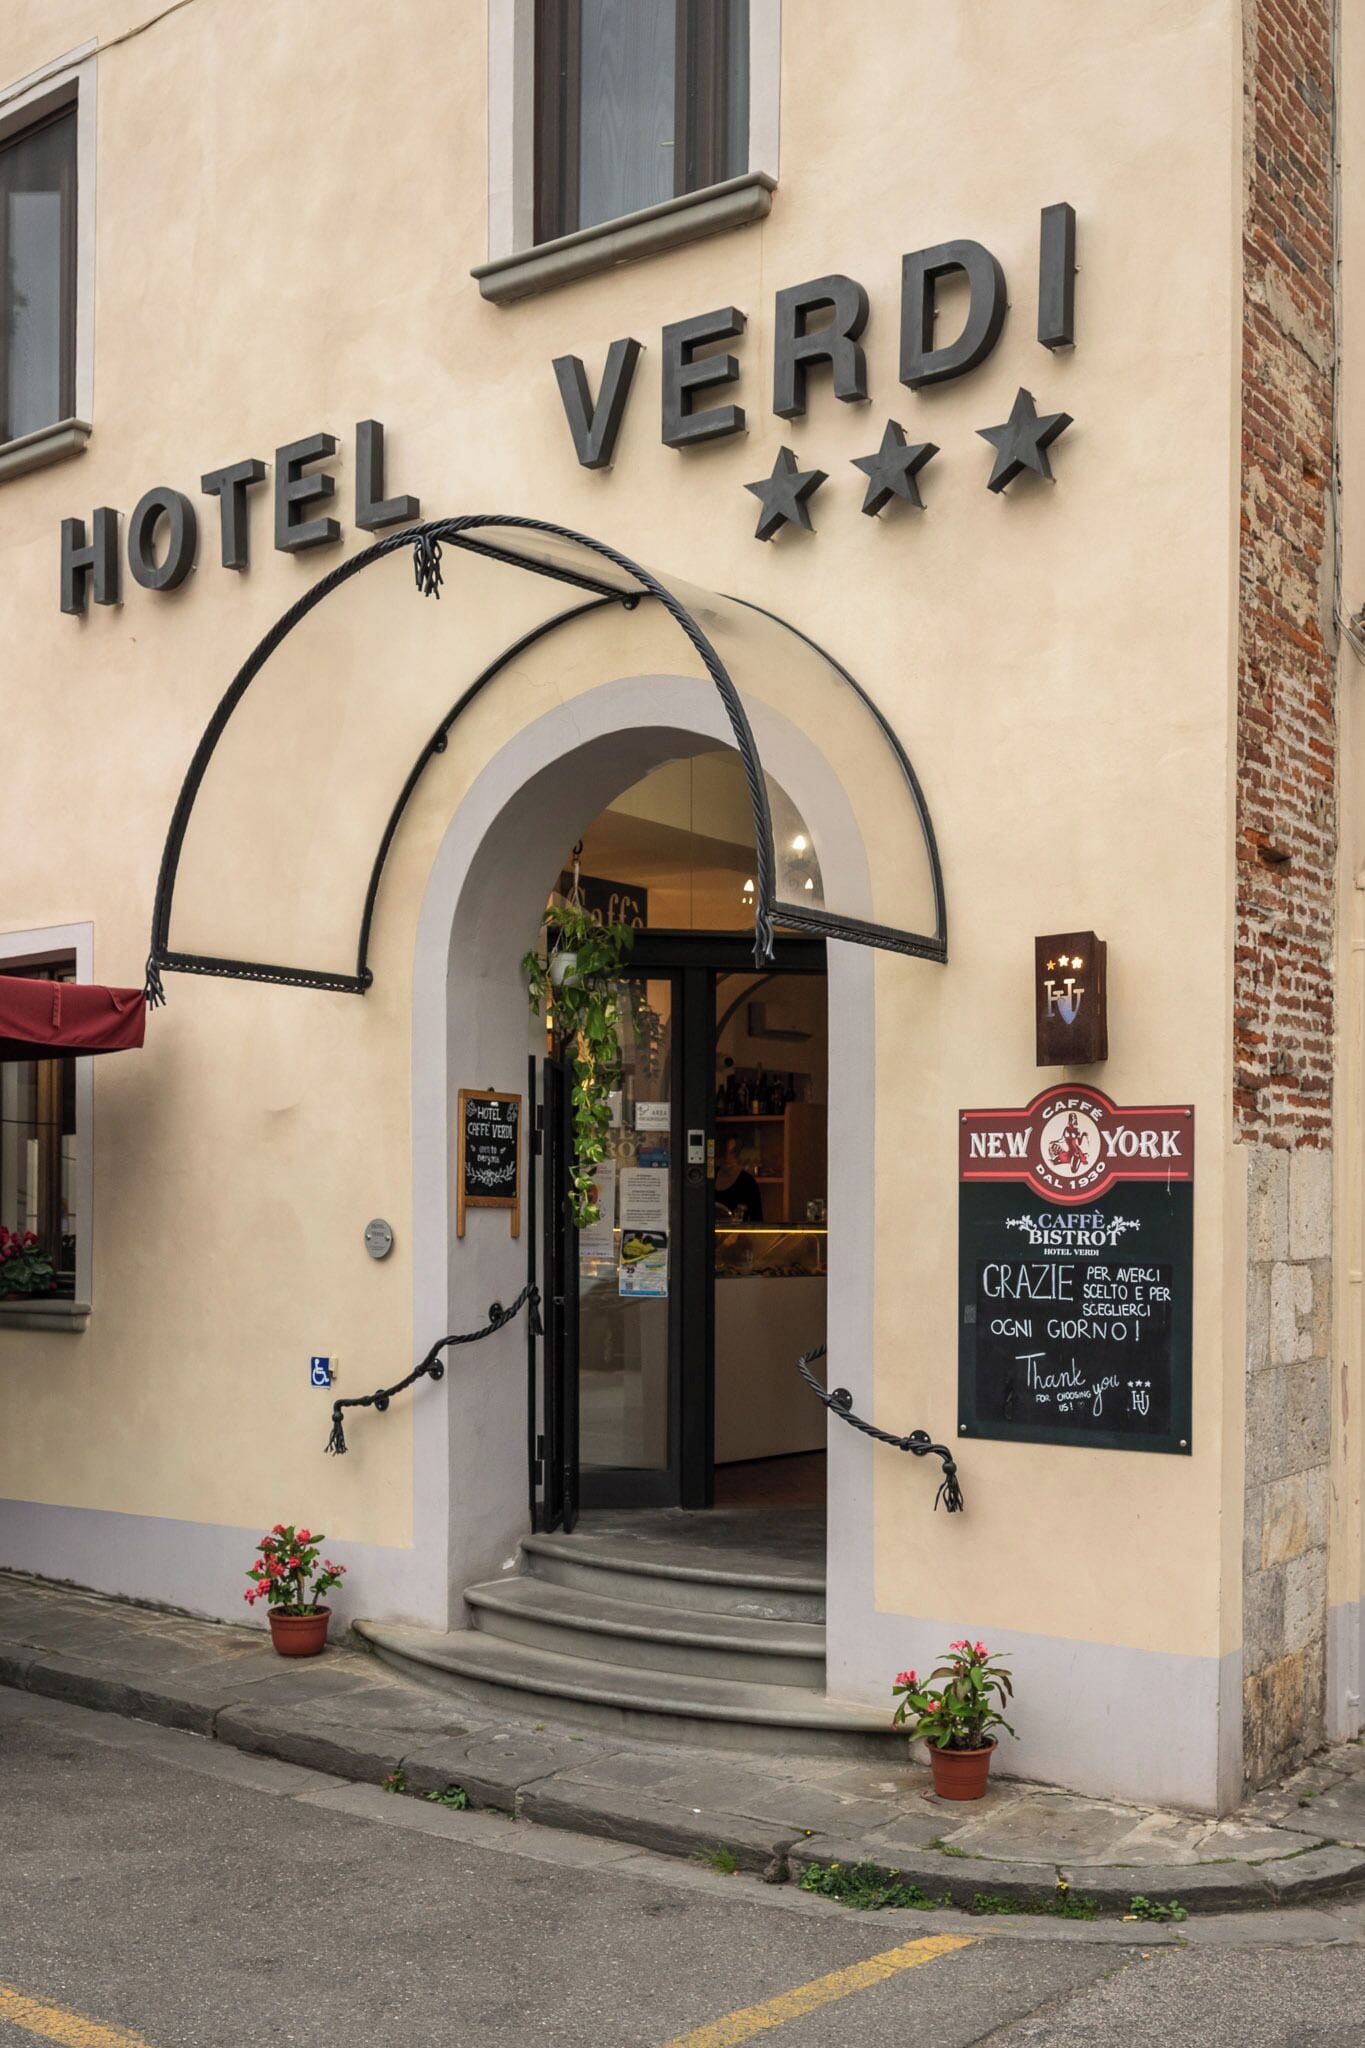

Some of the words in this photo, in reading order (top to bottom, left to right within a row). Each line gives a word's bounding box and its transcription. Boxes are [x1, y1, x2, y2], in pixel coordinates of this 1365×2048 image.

[59, 419, 421, 616] HOTEL
[551, 202, 1077, 471] VERDI
[477, 1106, 502, 1121] HOTEL
[491, 1124, 513, 1139] VERDI
[969, 1126, 1033, 1158] NEW
[1101, 1125, 1182, 1159] YORK
[1035, 1163, 1064, 1189] DAL
[1069, 1161, 1106, 1190] 1930
[1038, 1209, 1106, 1229] CAFFÈ
[1028, 1230, 1121, 1246] BISTROT
[1044, 1248, 1072, 1256] HOTEL
[1074, 1249, 1100, 1257] VERDI
[983, 1263, 1075, 1301] GRAZIE
[1086, 1266, 1111, 1282] PER
[1116, 1267, 1160, 1283] AVERCI
[1083, 1283, 1128, 1300] SCELTO
[1135, 1286, 1144, 1300] E
[1149, 1287, 1172, 1301] PER
[1082, 1303, 1151, 1317] SCEGLIERCI
[990, 1319, 1032, 1338] OGNI
[1015, 1352, 1086, 1390] Thank
[1092, 1375, 1120, 1417] you
[1035, 1394, 1051, 1403] FOR
[1056, 1390, 1091, 1402] CHOOSING
[1058, 1402, 1074, 1412] US!
